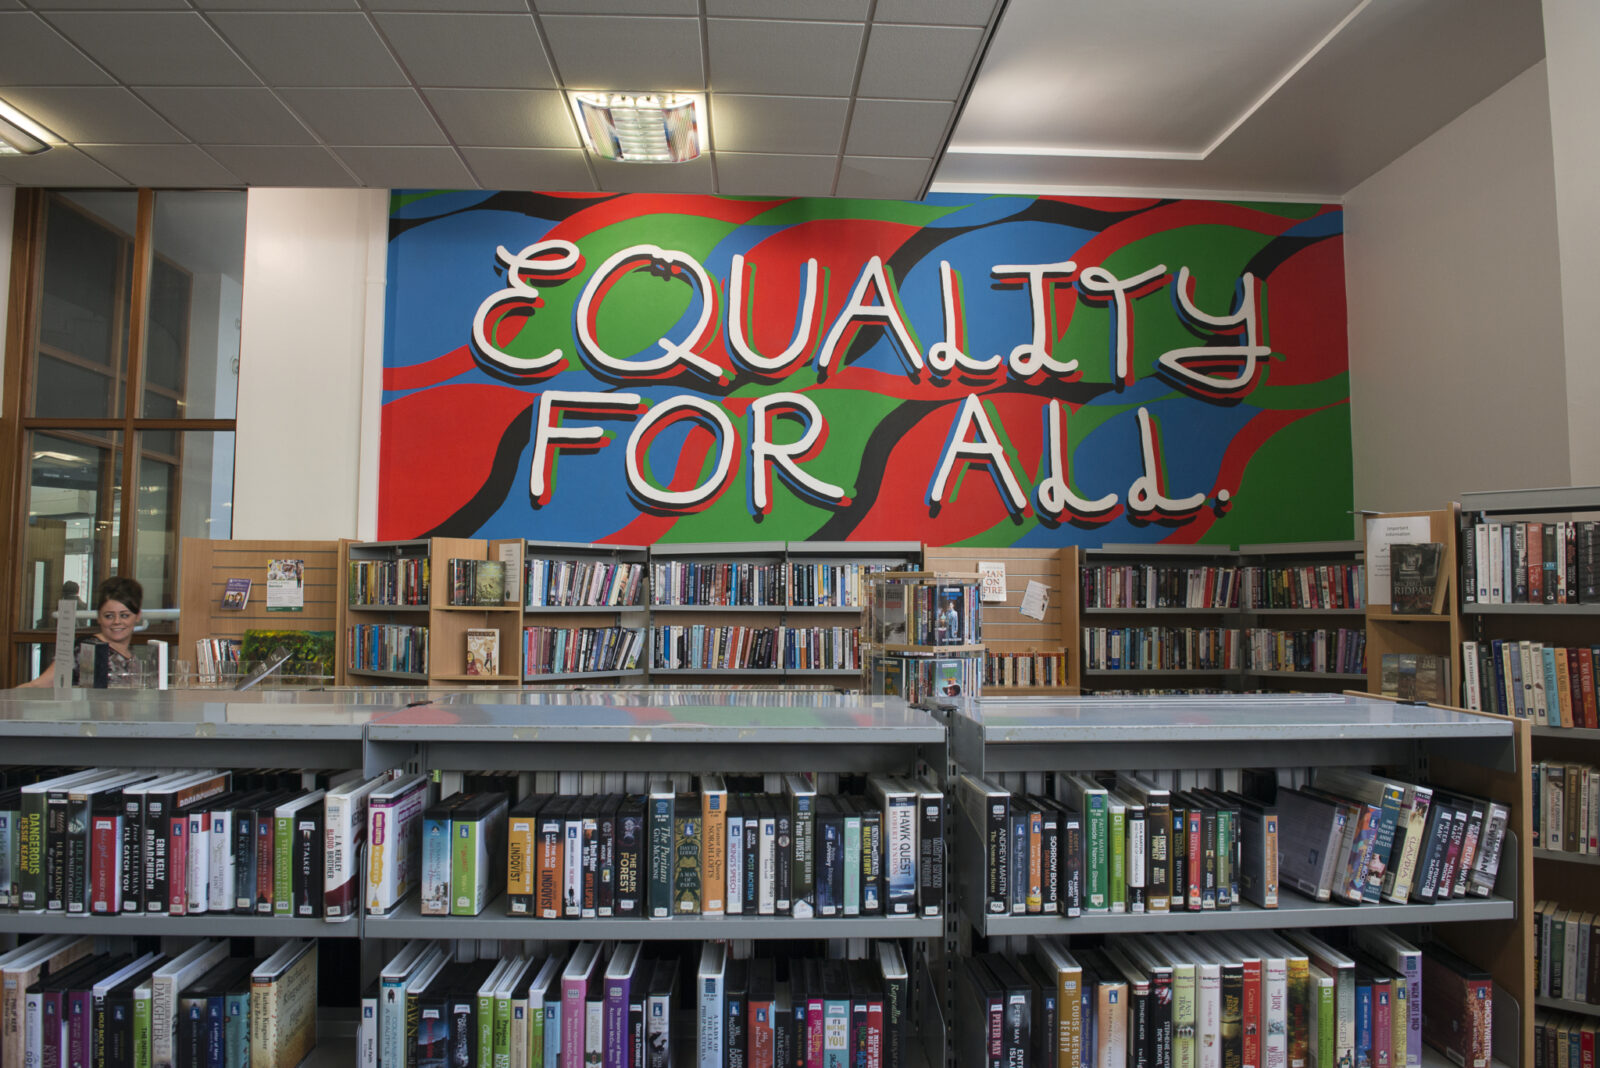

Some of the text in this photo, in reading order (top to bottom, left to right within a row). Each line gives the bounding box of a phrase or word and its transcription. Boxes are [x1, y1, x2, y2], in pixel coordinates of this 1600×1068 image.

[470, 240, 1270, 390] EQUALITY
[530, 390, 1230, 513] FOR ALL.
[29, 813, 40, 874] DANGEROUS
[796, 821, 804, 836] Peter
[863, 826, 871, 854] MALCOLM
[900, 811, 910, 876] HAWK QUEST
[1441, 822, 1449, 843] PETER
[1454, 822, 1464, 845] PETER
[1472, 821, 1481, 843] PETER
[1480, 817, 1501, 871] LEWIS MAN
[146, 829, 154, 889] BROADCHURCH
[156, 839, 165, 880] ERIN KELLY
[511, 842, 520, 882] LINDQVIST
[620, 852, 629, 892] FOREST
[660, 827, 671, 883] The Puritans
[714, 859, 722, 880] Queen
[1364, 846, 1373, 864] GLASS
[1441, 863, 1449, 881] ROOM
[1459, 846, 1473, 886] RUNAWAY
[541, 870, 553, 909] LINDQVIST
[154, 983, 164, 1041] DAUGHTER
[261, 1017, 269, 1050] Kingsolver
[714, 1043, 718, 1053] OF
[828, 1036, 844, 1046] YOU
[993, 1014, 1001, 1056] PETER MAY
[1060, 1021, 1070, 1052] BEAUTY
